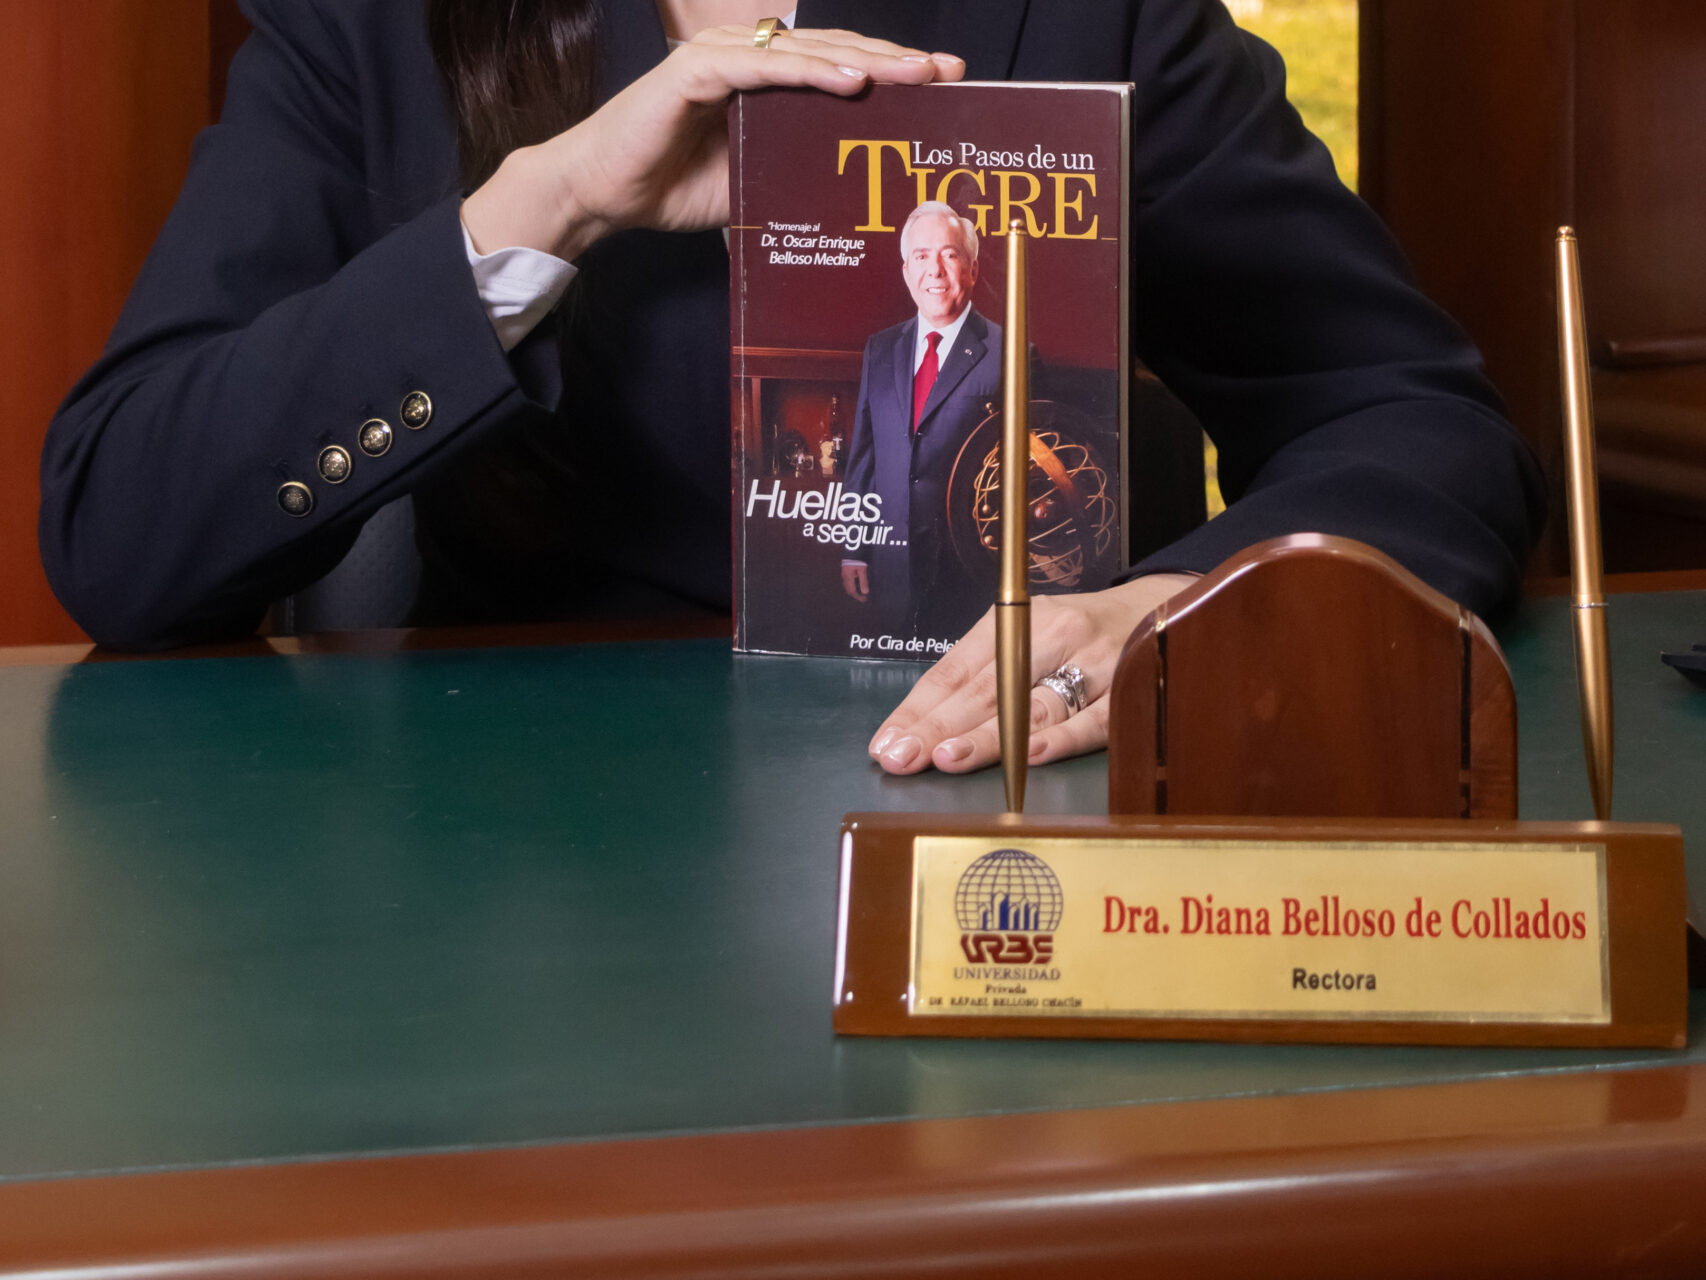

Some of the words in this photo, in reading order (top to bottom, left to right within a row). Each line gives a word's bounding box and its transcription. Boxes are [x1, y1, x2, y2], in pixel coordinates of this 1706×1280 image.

[912, 141, 953, 165] Los
[958, 142, 1024, 168] Pasos
[1027, 144, 1056, 169] de
[1062, 152, 1095, 170] un
[837, 139, 1099, 240] TIGRE
[812, 222, 821, 232] al
[761, 234, 779, 248] Dr.
[782, 235, 818, 249] Oscar
[818, 235, 865, 253] Enrique
[769, 251, 812, 265] Belloso
[746, 479, 883, 523] Huellas
[803, 523, 814, 537] a
[816, 519, 908, 551] seguir...
[850, 634, 874, 650] Por
[877, 634, 904, 651] Cira
[905, 636, 925, 652] de
[925, 637, 960, 654] Pele
[1102, 895, 1170, 935] Dra.
[1180, 894, 1272, 937] Diana
[1281, 895, 1396, 938] Belloso
[1405, 897, 1442, 938] de
[1451, 898, 1587, 940] Collados
[953, 967, 1062, 981] UNIVERSIDAD
[1291, 968, 1377, 992] Rectora
[985, 983, 1027, 995] Privada
